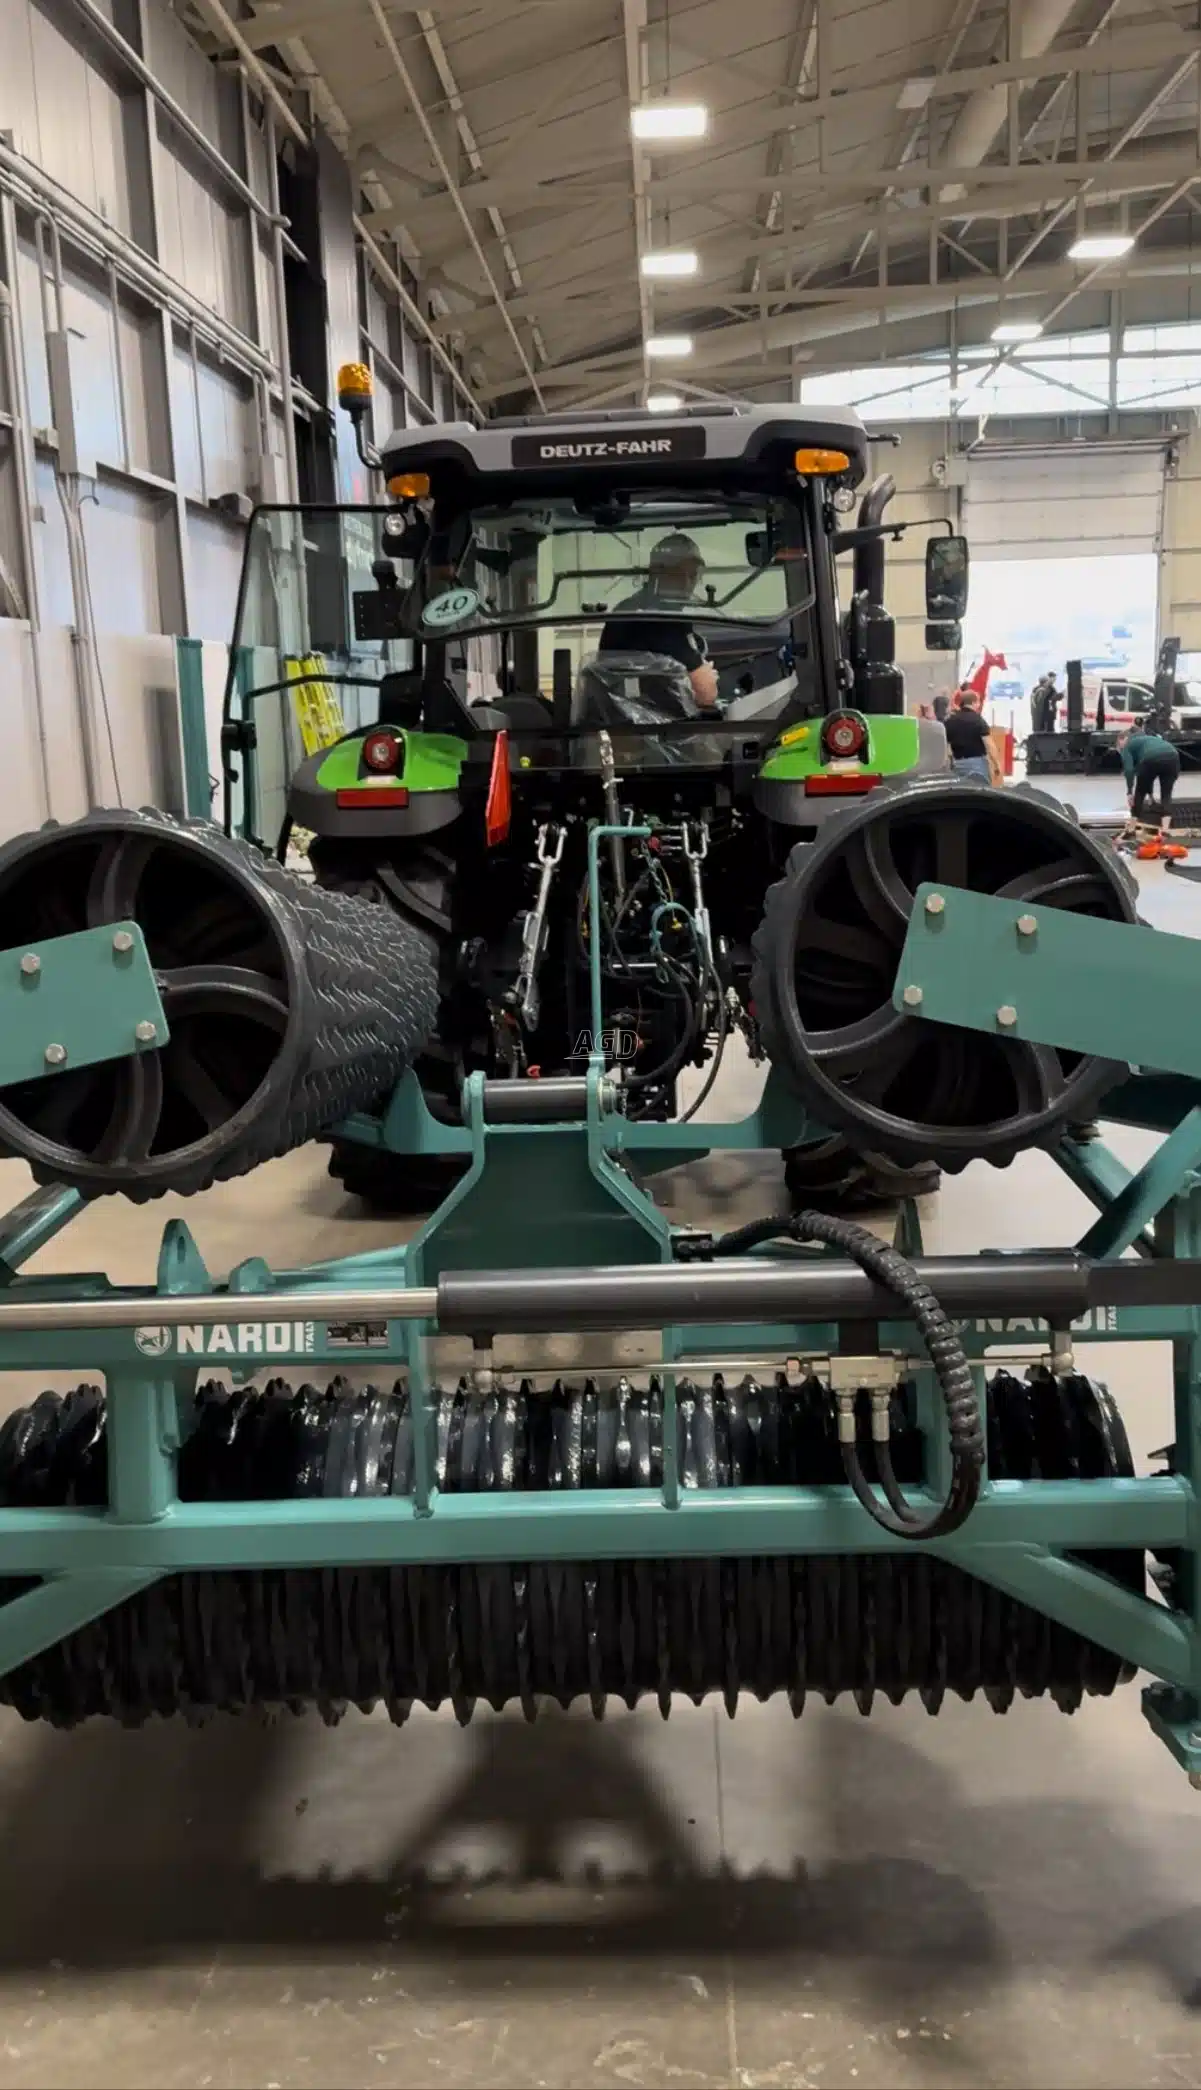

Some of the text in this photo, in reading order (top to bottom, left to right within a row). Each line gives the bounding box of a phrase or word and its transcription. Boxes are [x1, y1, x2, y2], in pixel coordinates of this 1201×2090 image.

[540, 439, 672, 458] DEUTZ-FAHR
[435, 596, 468, 612] 40
[177, 1322, 304, 1353] NARDI
